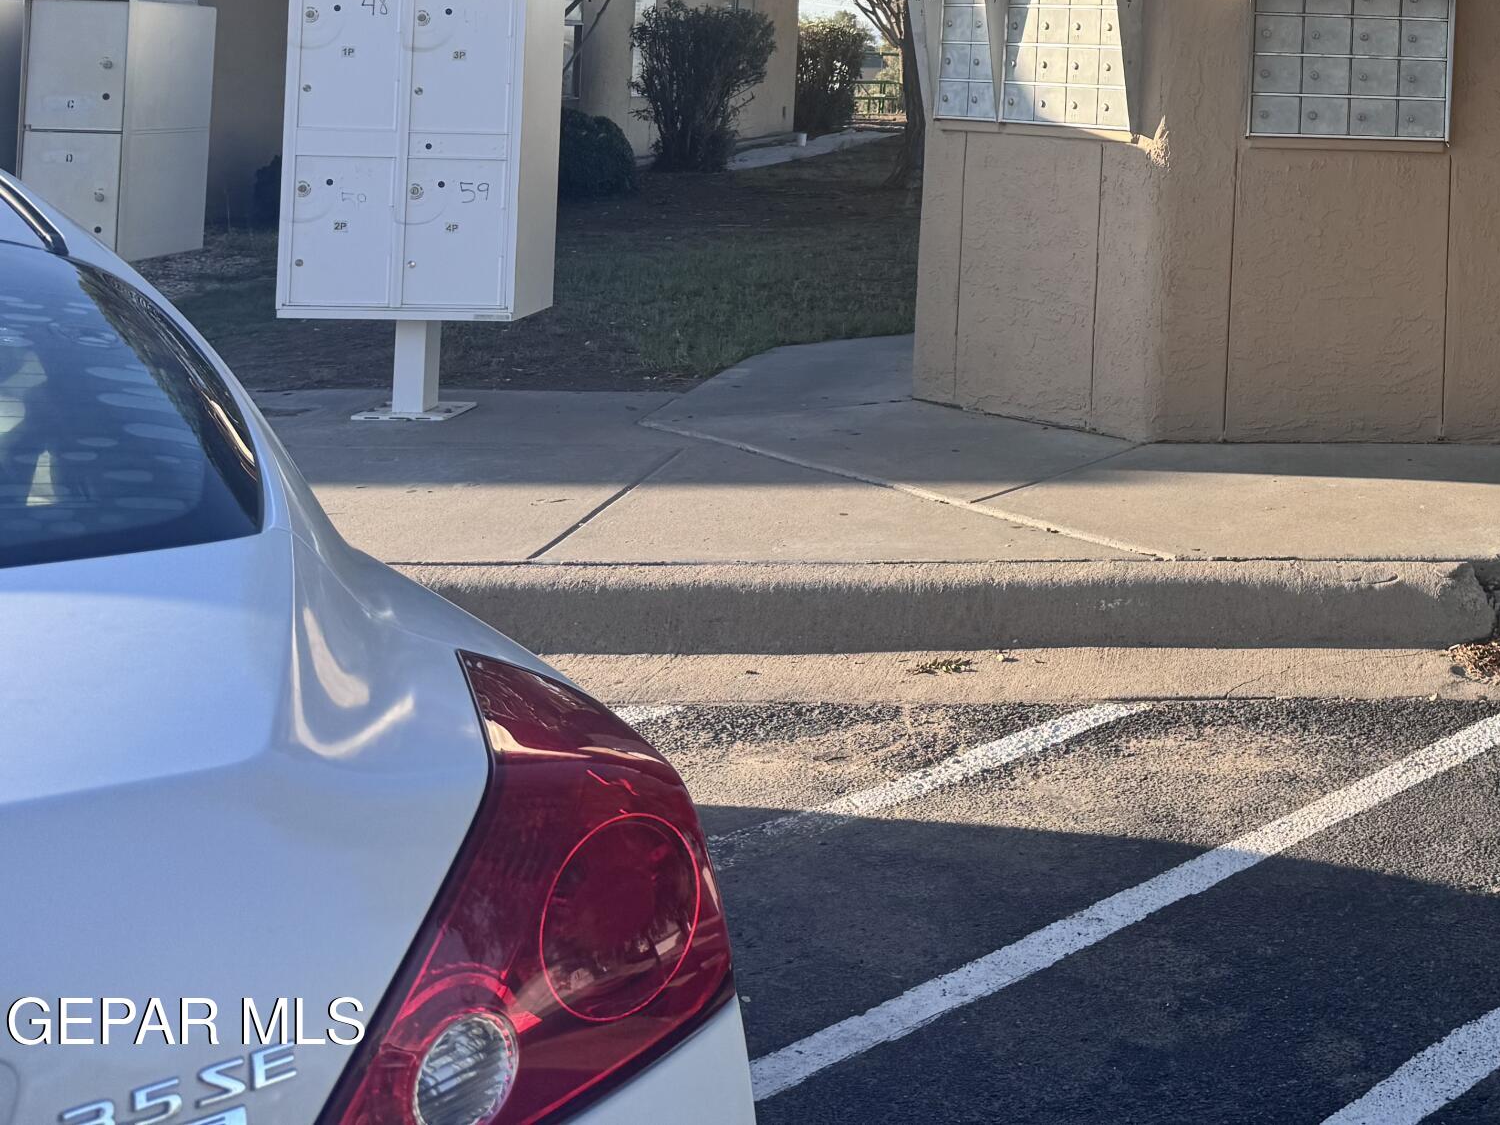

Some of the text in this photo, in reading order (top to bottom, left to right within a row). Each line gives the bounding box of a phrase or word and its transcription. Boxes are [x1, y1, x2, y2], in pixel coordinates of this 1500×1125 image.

[1126, 0, 1133, 9] 7
[341, 48, 355, 57] 1P
[452, 50, 466, 60] 3P
[459, 181, 490, 204] 59
[333, 222, 347, 231] 2P
[445, 224, 459, 233] 4P
[193, 1041, 298, 1108] SE
